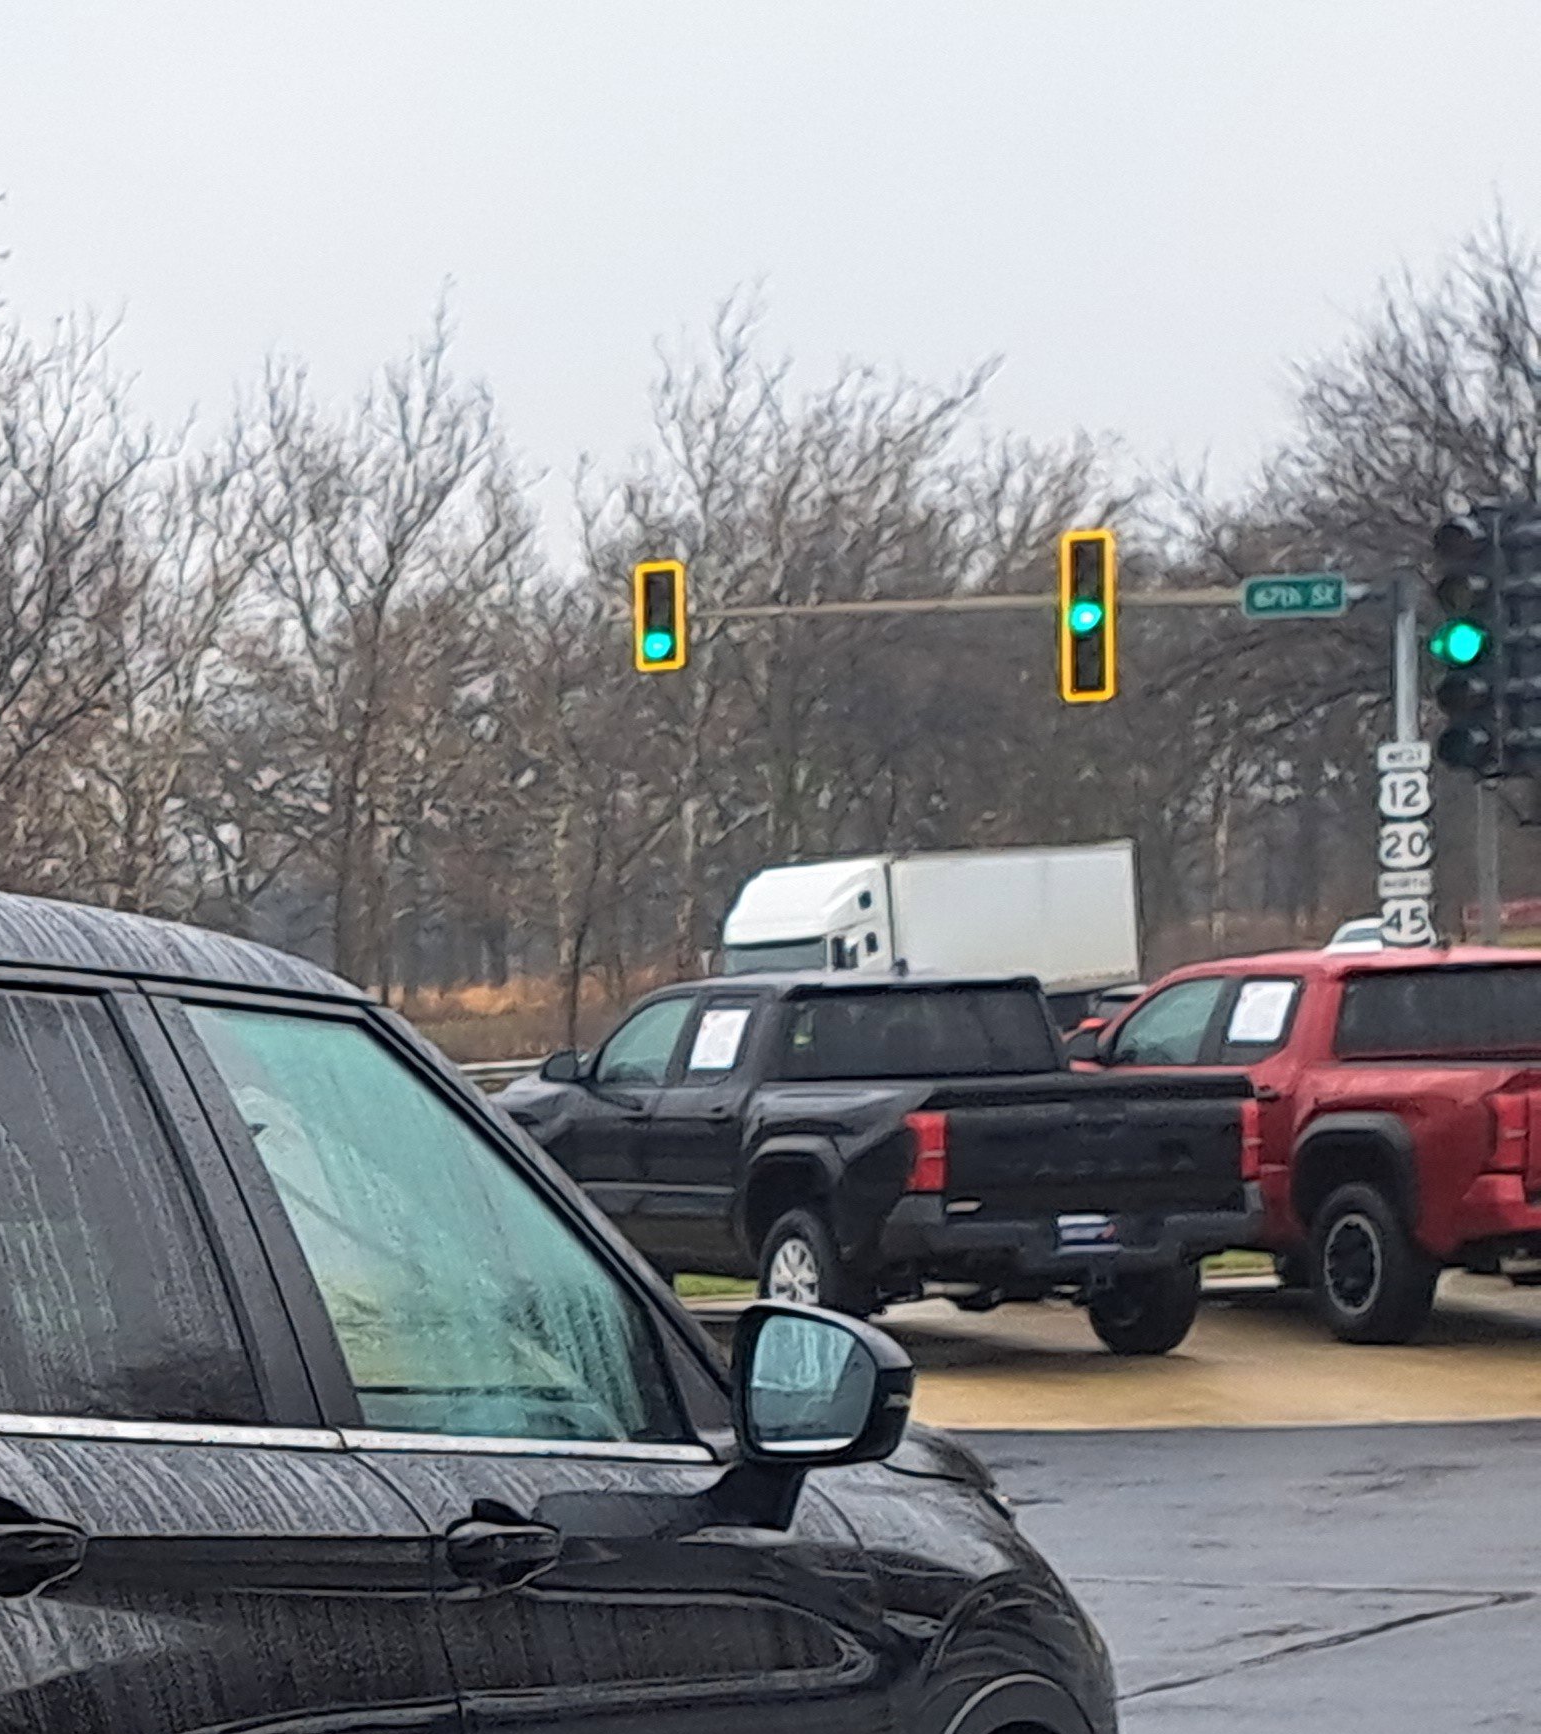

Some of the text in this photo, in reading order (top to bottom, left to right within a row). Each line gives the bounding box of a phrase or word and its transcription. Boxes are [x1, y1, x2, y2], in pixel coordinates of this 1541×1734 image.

[1389, 780, 1421, 809] 12
[1385, 830, 1428, 860] 20
[1386, 906, 1428, 936] 45
